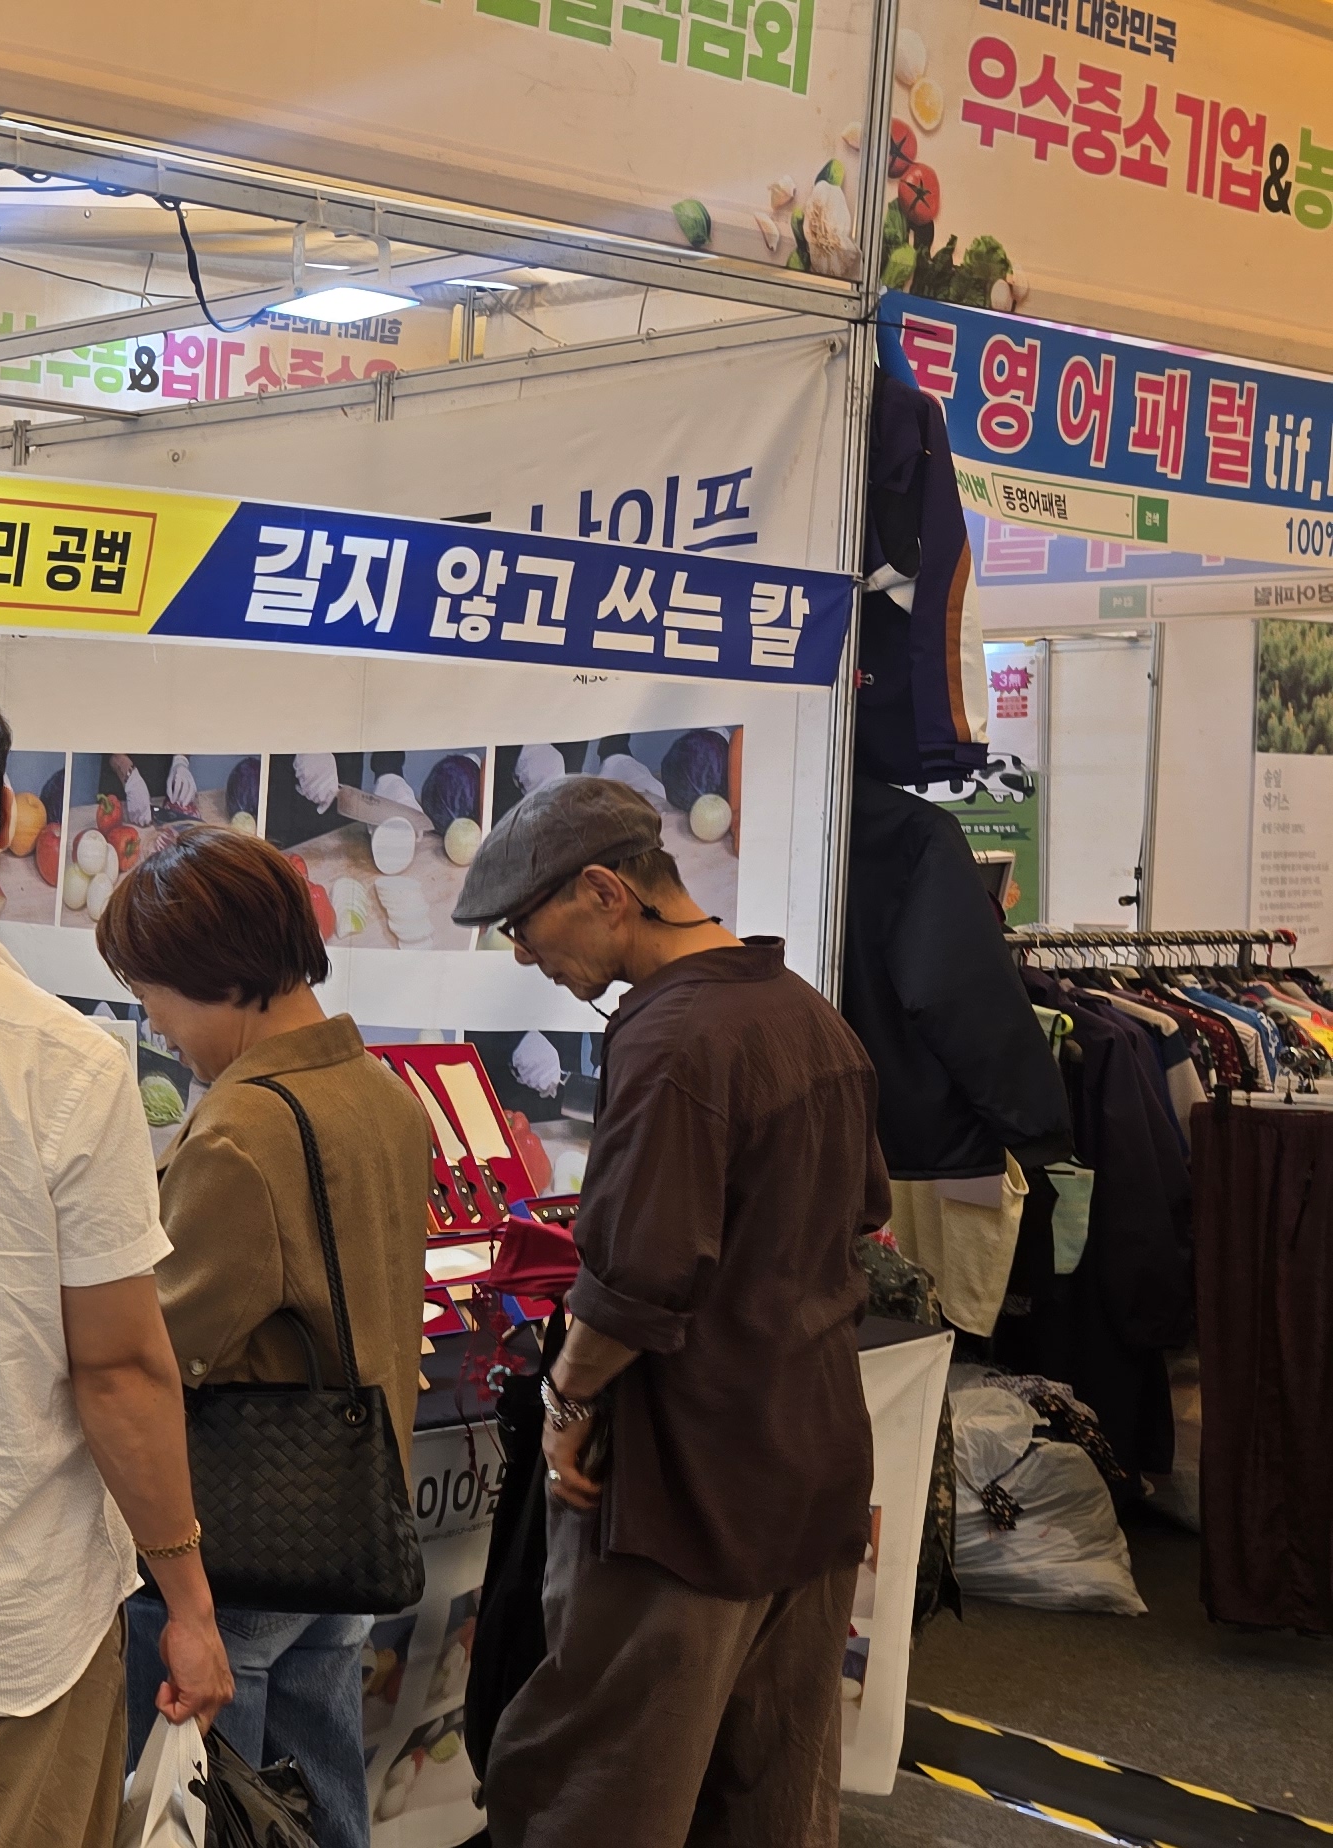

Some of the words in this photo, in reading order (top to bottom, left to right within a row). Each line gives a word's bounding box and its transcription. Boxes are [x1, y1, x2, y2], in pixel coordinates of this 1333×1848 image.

[1076, 0, 1177, 63] 대한민국
[45, 525, 132, 594] 공법
[244, 525, 408, 634] 갈지
[430, 545, 575, 644] 않고
[592, 564, 723, 663] 쓰는
[749, 582, 810, 669] 칼
